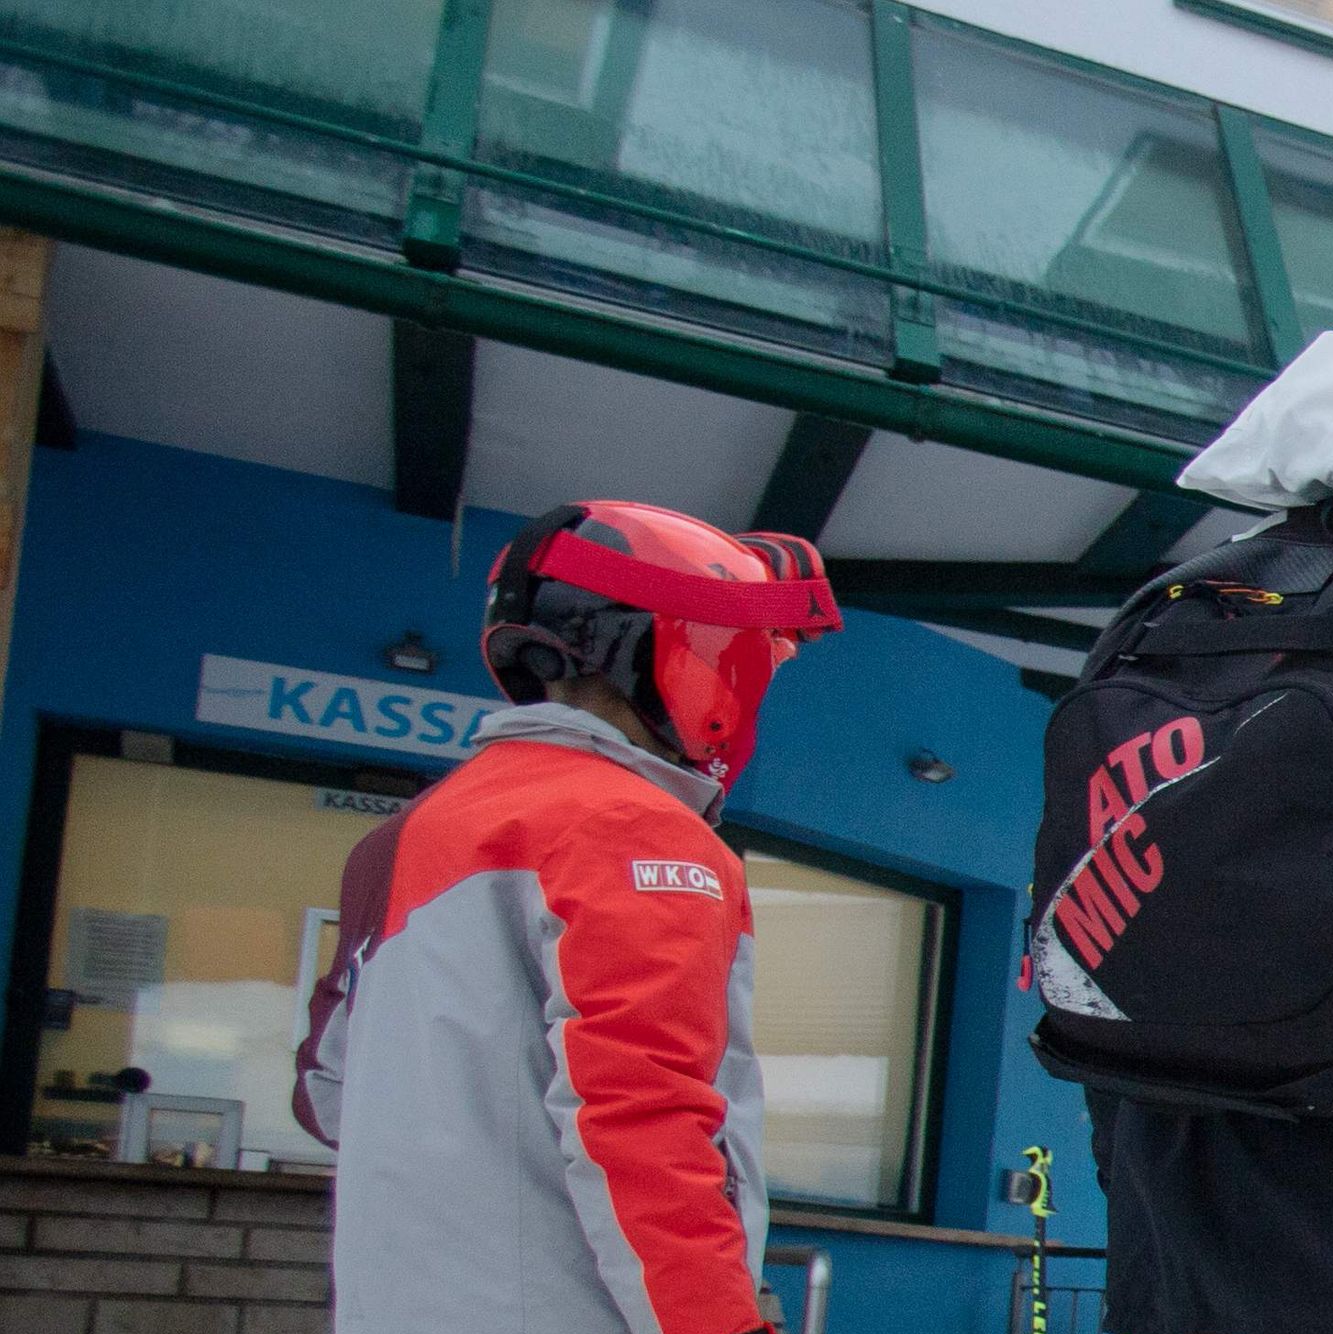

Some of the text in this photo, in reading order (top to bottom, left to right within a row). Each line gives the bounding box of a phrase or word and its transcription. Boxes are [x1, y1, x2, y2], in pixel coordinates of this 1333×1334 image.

[1087, 716, 1206, 842] ATO
[636, 861, 705, 890] WKO
[1054, 811, 1165, 970] MIC
